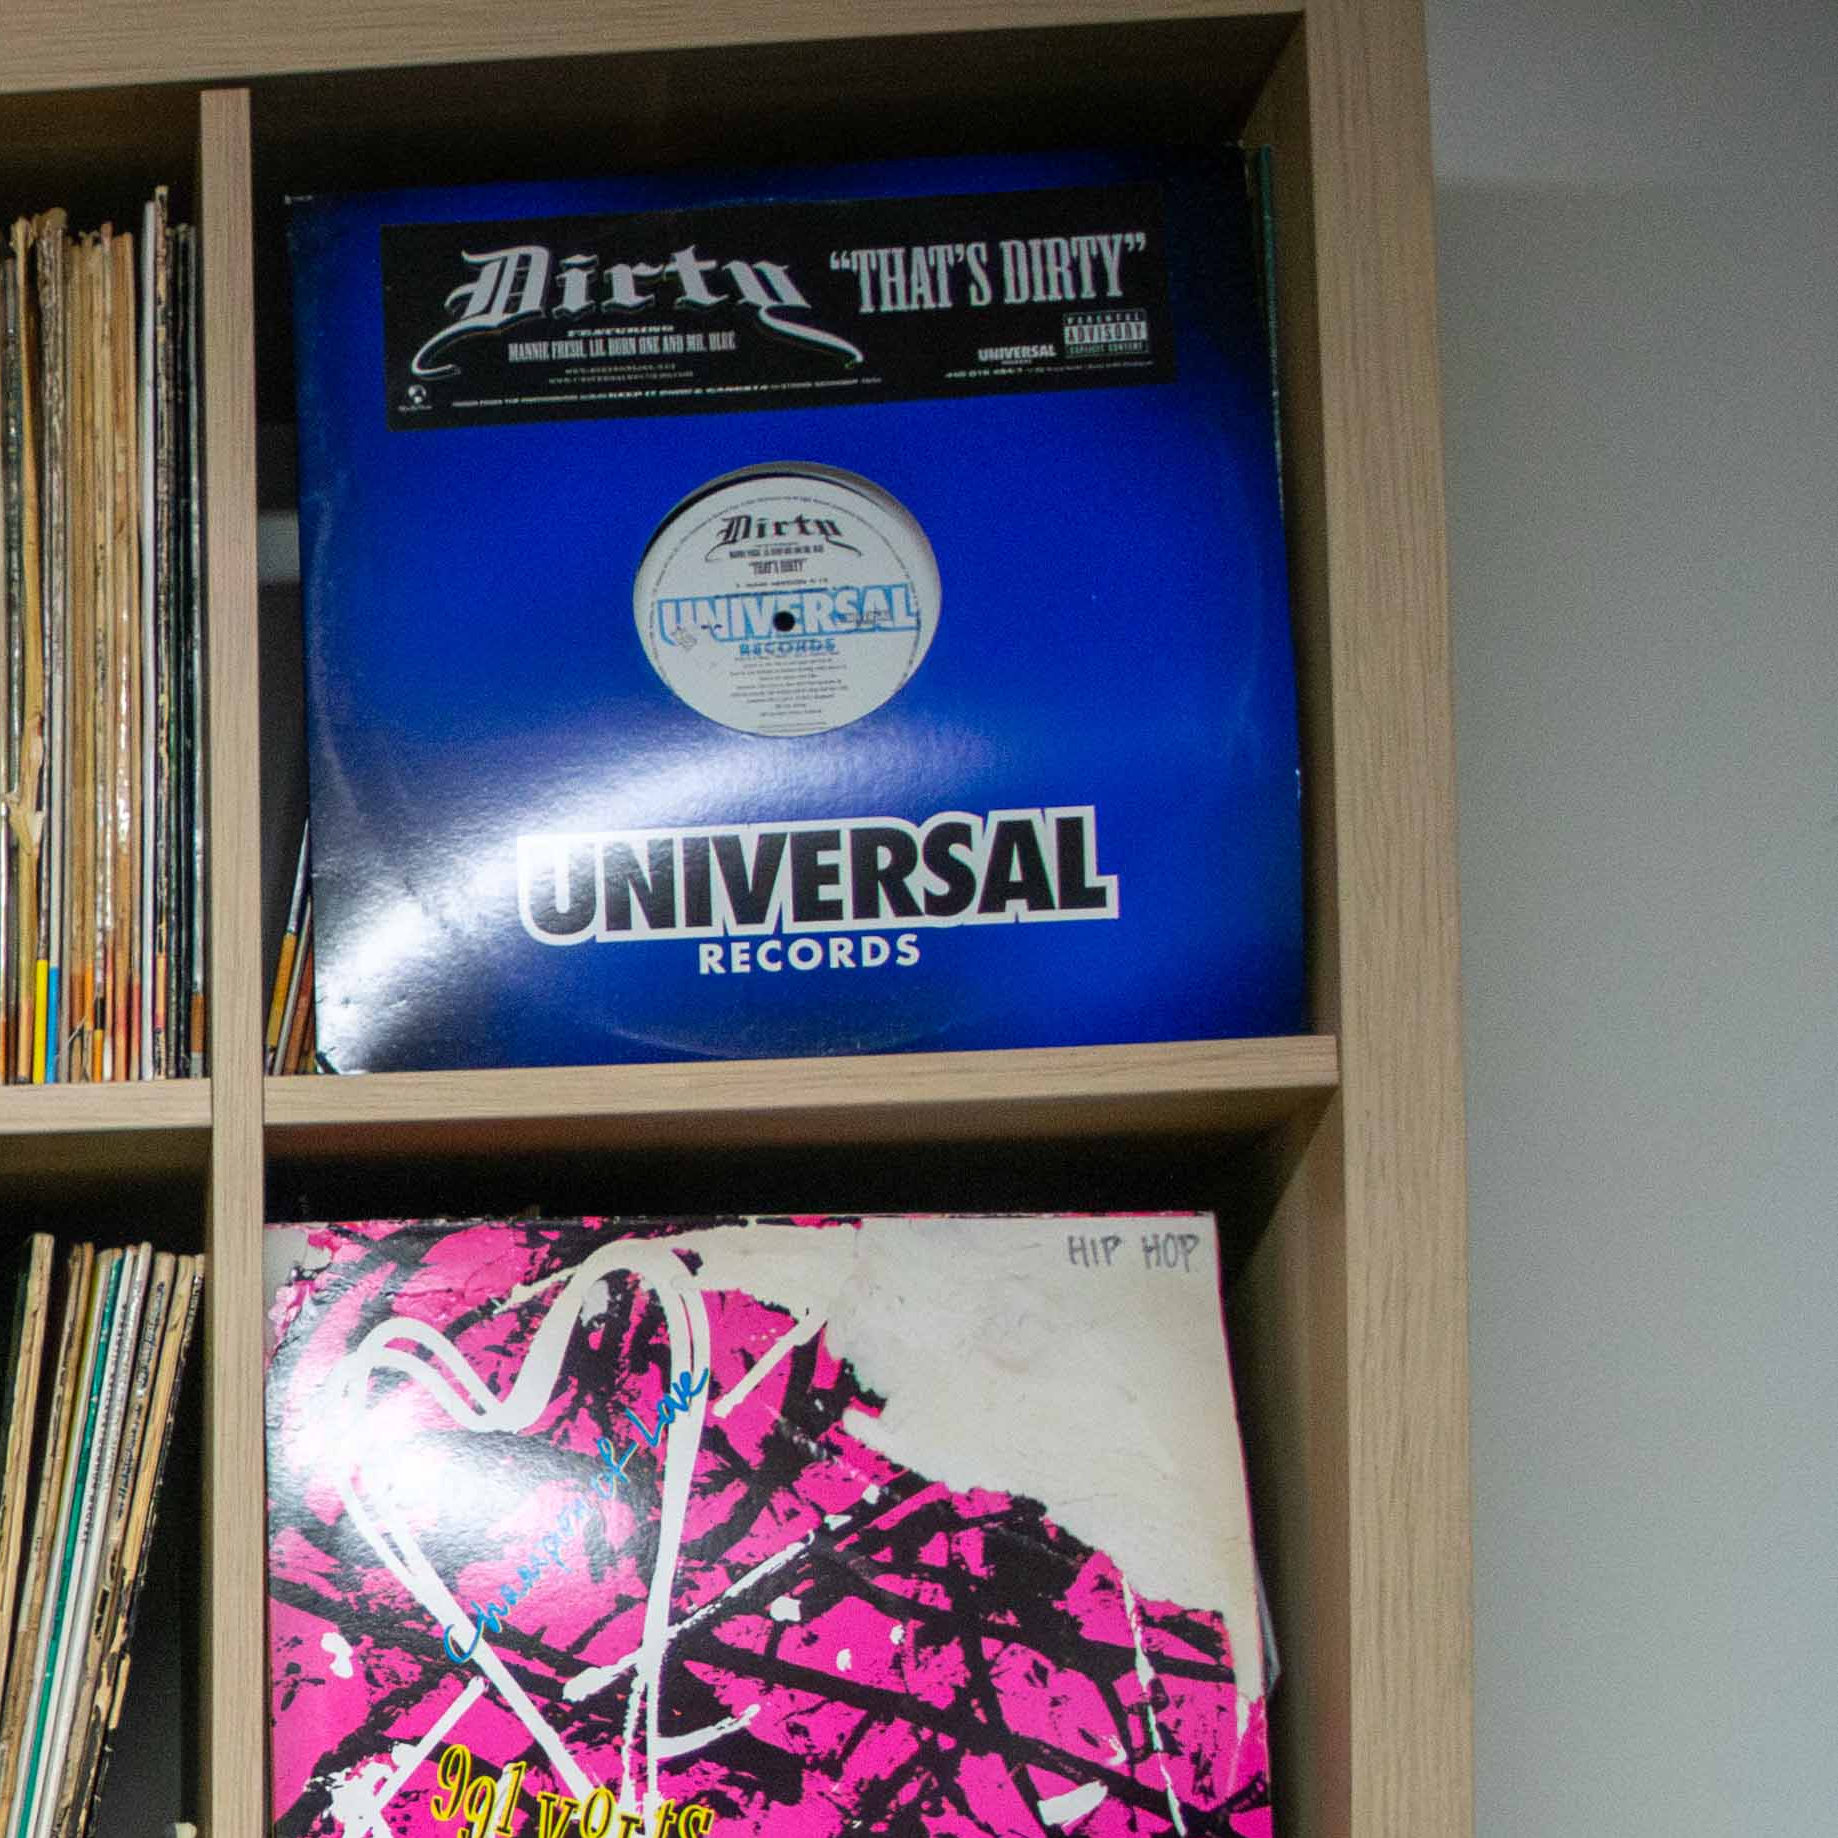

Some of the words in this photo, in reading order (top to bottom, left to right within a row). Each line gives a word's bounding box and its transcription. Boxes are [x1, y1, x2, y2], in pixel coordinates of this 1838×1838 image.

[411, 244, 864, 376] Dirty
[1067, 321, 1145, 345] ADVISORY
[977, 343, 1057, 362] UNIVERSAL
[705, 513, 863, 563] Dirty
[658, 582, 921, 646] UNIVERSAL
[518, 805, 1119, 946] UNIVERSAL
[698, 933, 922, 975] RECORDS
[1067, 1234, 1123, 1269] HIP
[1140, 1232, 1201, 1273] HOP
